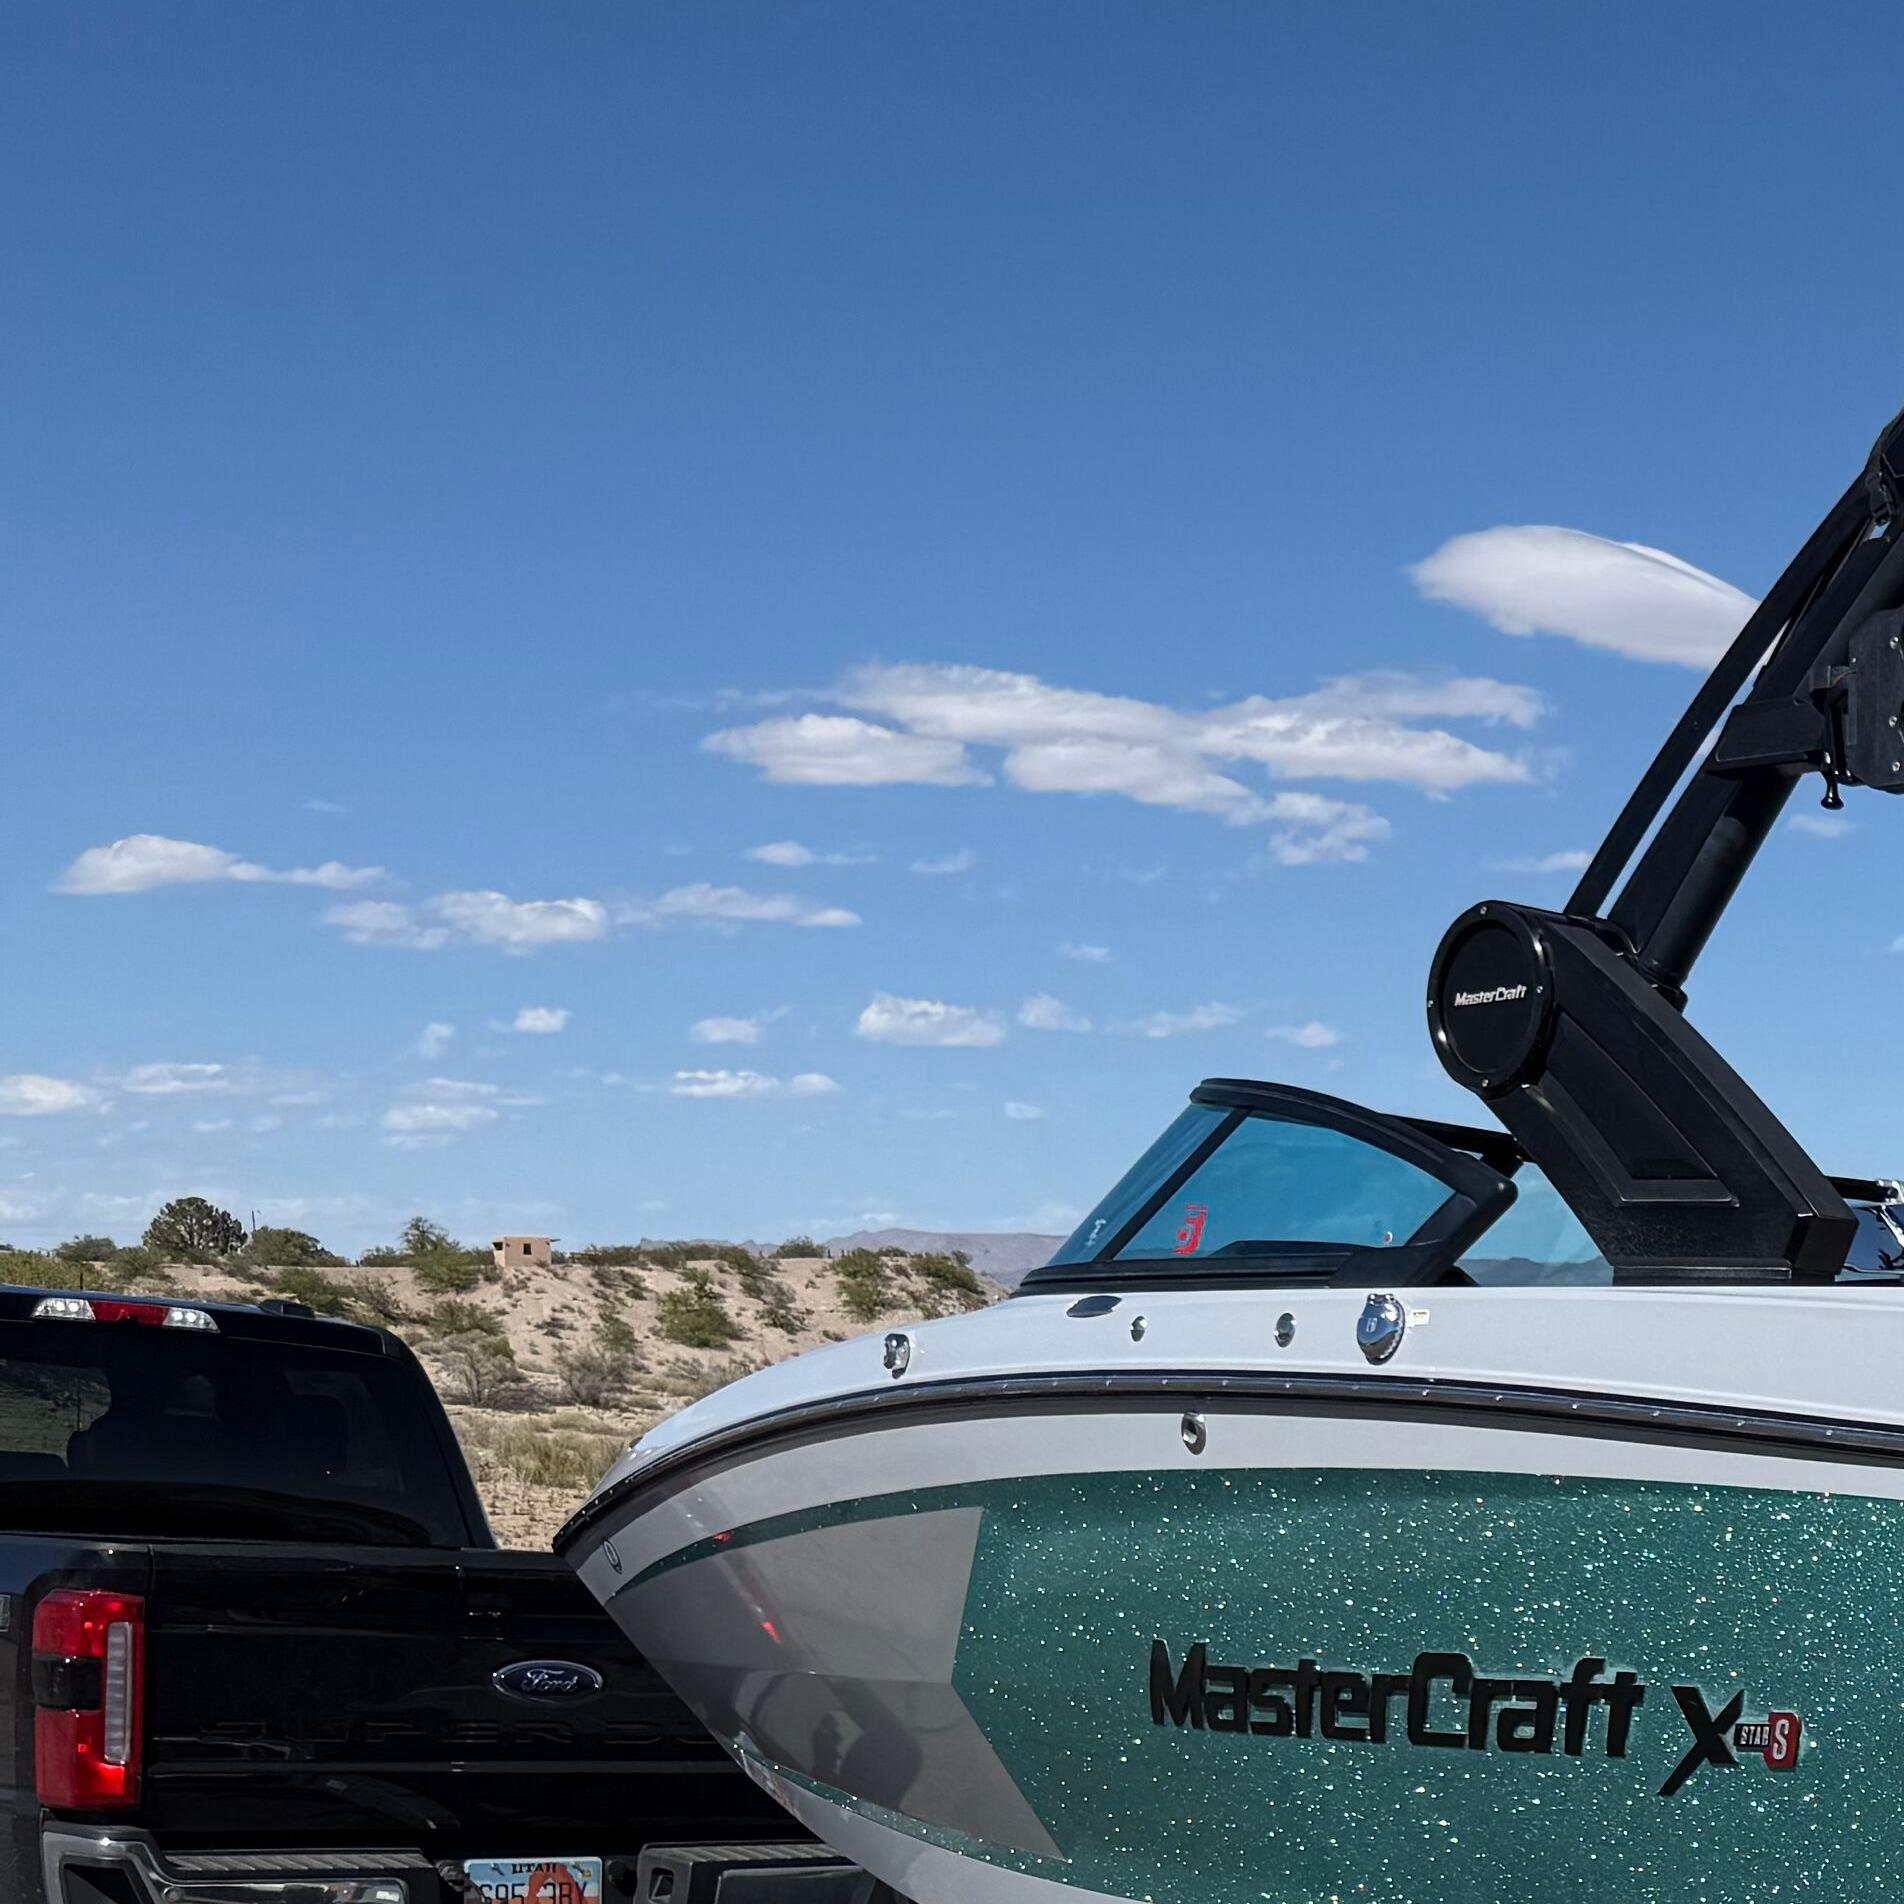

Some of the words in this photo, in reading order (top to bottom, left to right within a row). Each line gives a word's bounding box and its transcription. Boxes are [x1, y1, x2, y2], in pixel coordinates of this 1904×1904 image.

[1454, 984, 1527, 1007] MasterCraft
[520, 1668, 579, 1693] Ford
[1148, 1638, 1645, 1758] MasterCraft
[511, 1862, 557, 1875] UTAH
